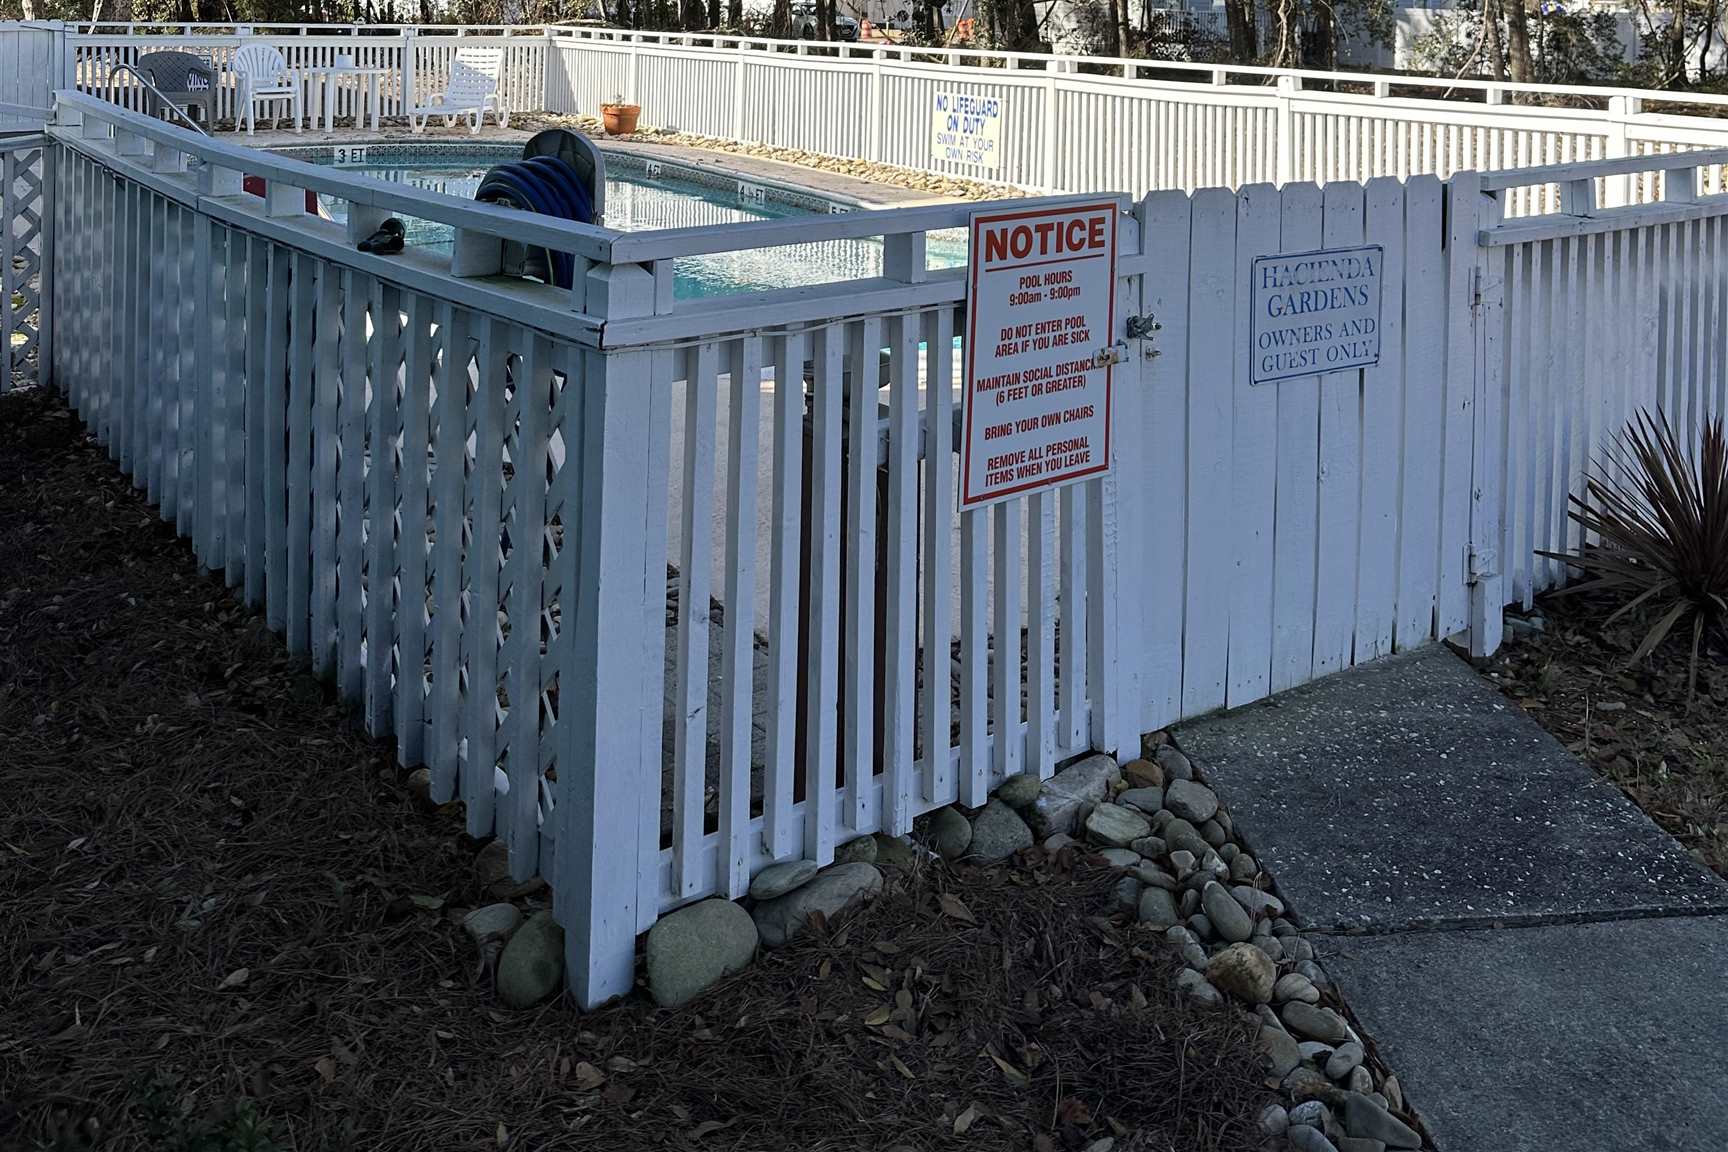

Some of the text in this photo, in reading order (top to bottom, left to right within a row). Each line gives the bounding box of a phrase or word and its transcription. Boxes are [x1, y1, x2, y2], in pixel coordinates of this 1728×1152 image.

[936, 94, 998, 118] NO LIFEGUARD
[946, 114, 985, 136] ON DUTY
[338, 148, 346, 164] 3
[936, 132, 994, 152] SWIM AT YOUR
[945, 147, 984, 164] OWN RISK
[985, 216, 1106, 262] NOTICE
[1019, 270, 1073, 290] POOL HOURS
[1262, 256, 1376, 289] HACIENDA
[1009, 291, 1041, 306] 9:00am
[1049, 285, 1081, 301] 9:00pm
[1267, 284, 1369, 318] GARDENS
[1000, 315, 1086, 342] DO NOT ENTER POOL
[1258, 317, 1376, 350] OWNERS AND
[994, 329, 1090, 358] AREA IF YOU ARE SICK
[1262, 339, 1373, 373] GUEST ONLY
[976, 371, 1021, 393] MAINTAIN
[1022, 366, 1053, 383] SOCIAL
[995, 375, 1087, 406] (6 FEET OR GREATER)
[984, 405, 1094, 440] BRING YOUR OWN CHAIRS
[987, 436, 1089, 471] REMOVE ALL PERSONAL
[985, 450, 1091, 487] ITEMS WHEN YOU LEAVE
